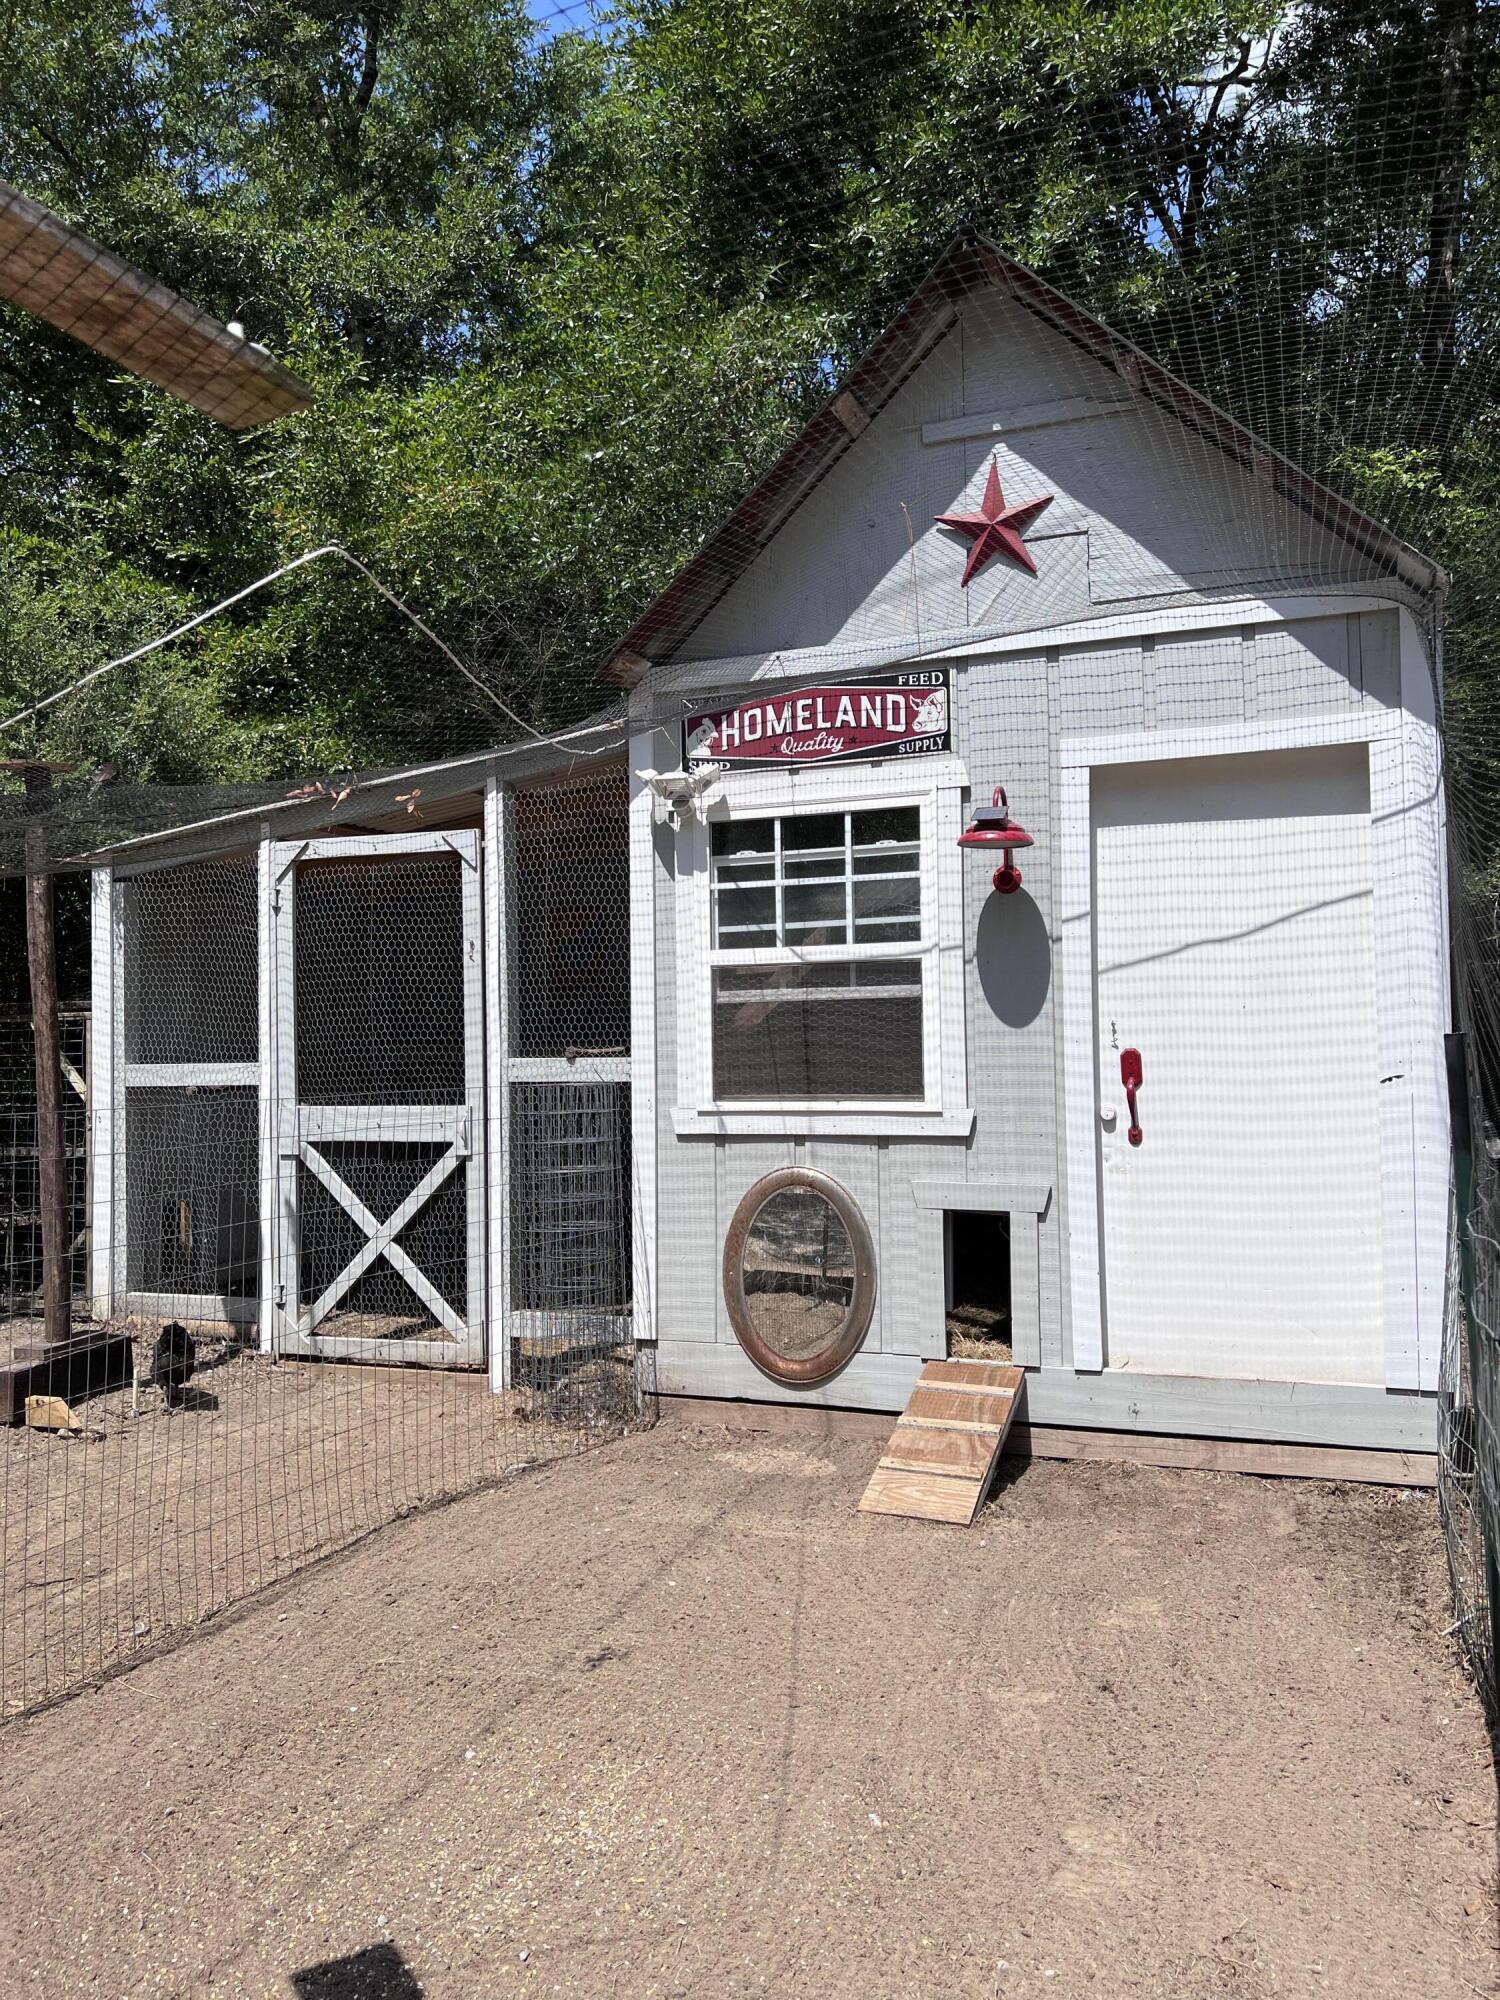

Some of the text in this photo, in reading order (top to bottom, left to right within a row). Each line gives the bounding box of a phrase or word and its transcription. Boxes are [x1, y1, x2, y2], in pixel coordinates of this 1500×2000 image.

[898, 672, 943, 685] FEED
[721, 693, 906, 751] HOMELAND
[781, 731, 844, 754] Quality
[899, 736, 944, 753] SUPPLY
